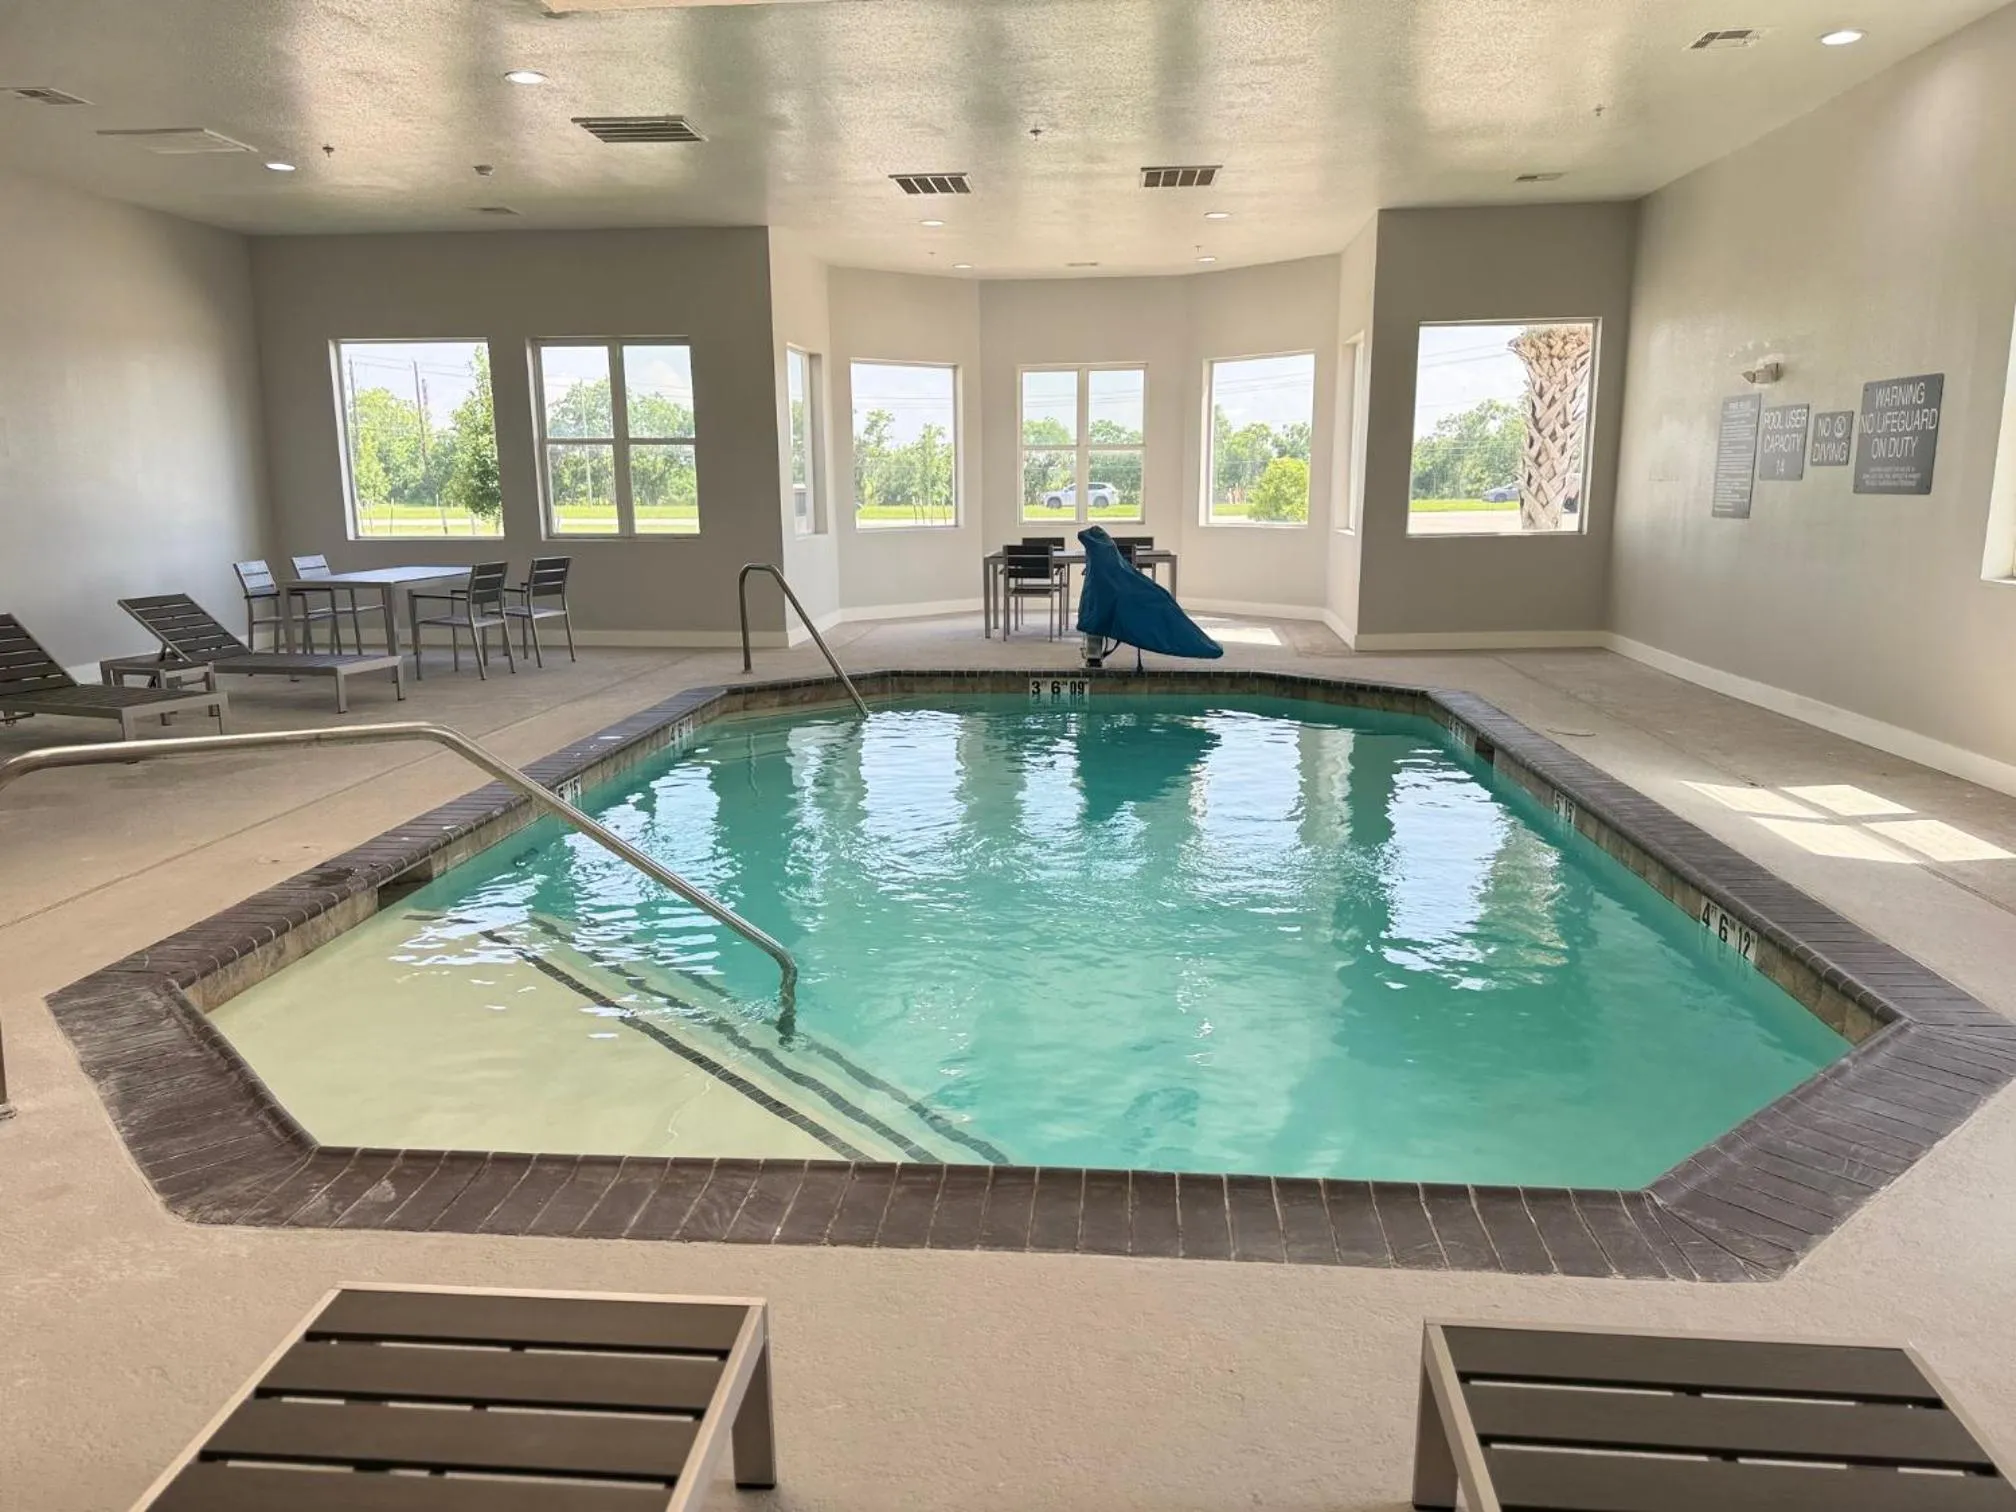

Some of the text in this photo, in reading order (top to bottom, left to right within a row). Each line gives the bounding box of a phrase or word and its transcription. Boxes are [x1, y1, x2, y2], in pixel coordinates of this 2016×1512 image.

[1875, 382, 1926, 409] WARNING
[1764, 408, 1808, 431] POOL USER
[1818, 417, 1832, 438] NO
[1860, 408, 1938, 434] NO LIFEGUARD
[1764, 432, 1803, 453] CAPACITY
[1812, 442, 1848, 462] DIVING
[1871, 436, 1919, 460] ON DUTY
[1031, 680, 1041, 695] 3
[1050, 680, 1061, 695] 6
[1702, 902, 1710, 928] 4
[1719, 913, 1729, 943] 6
[1738, 926, 1751, 961] 12
